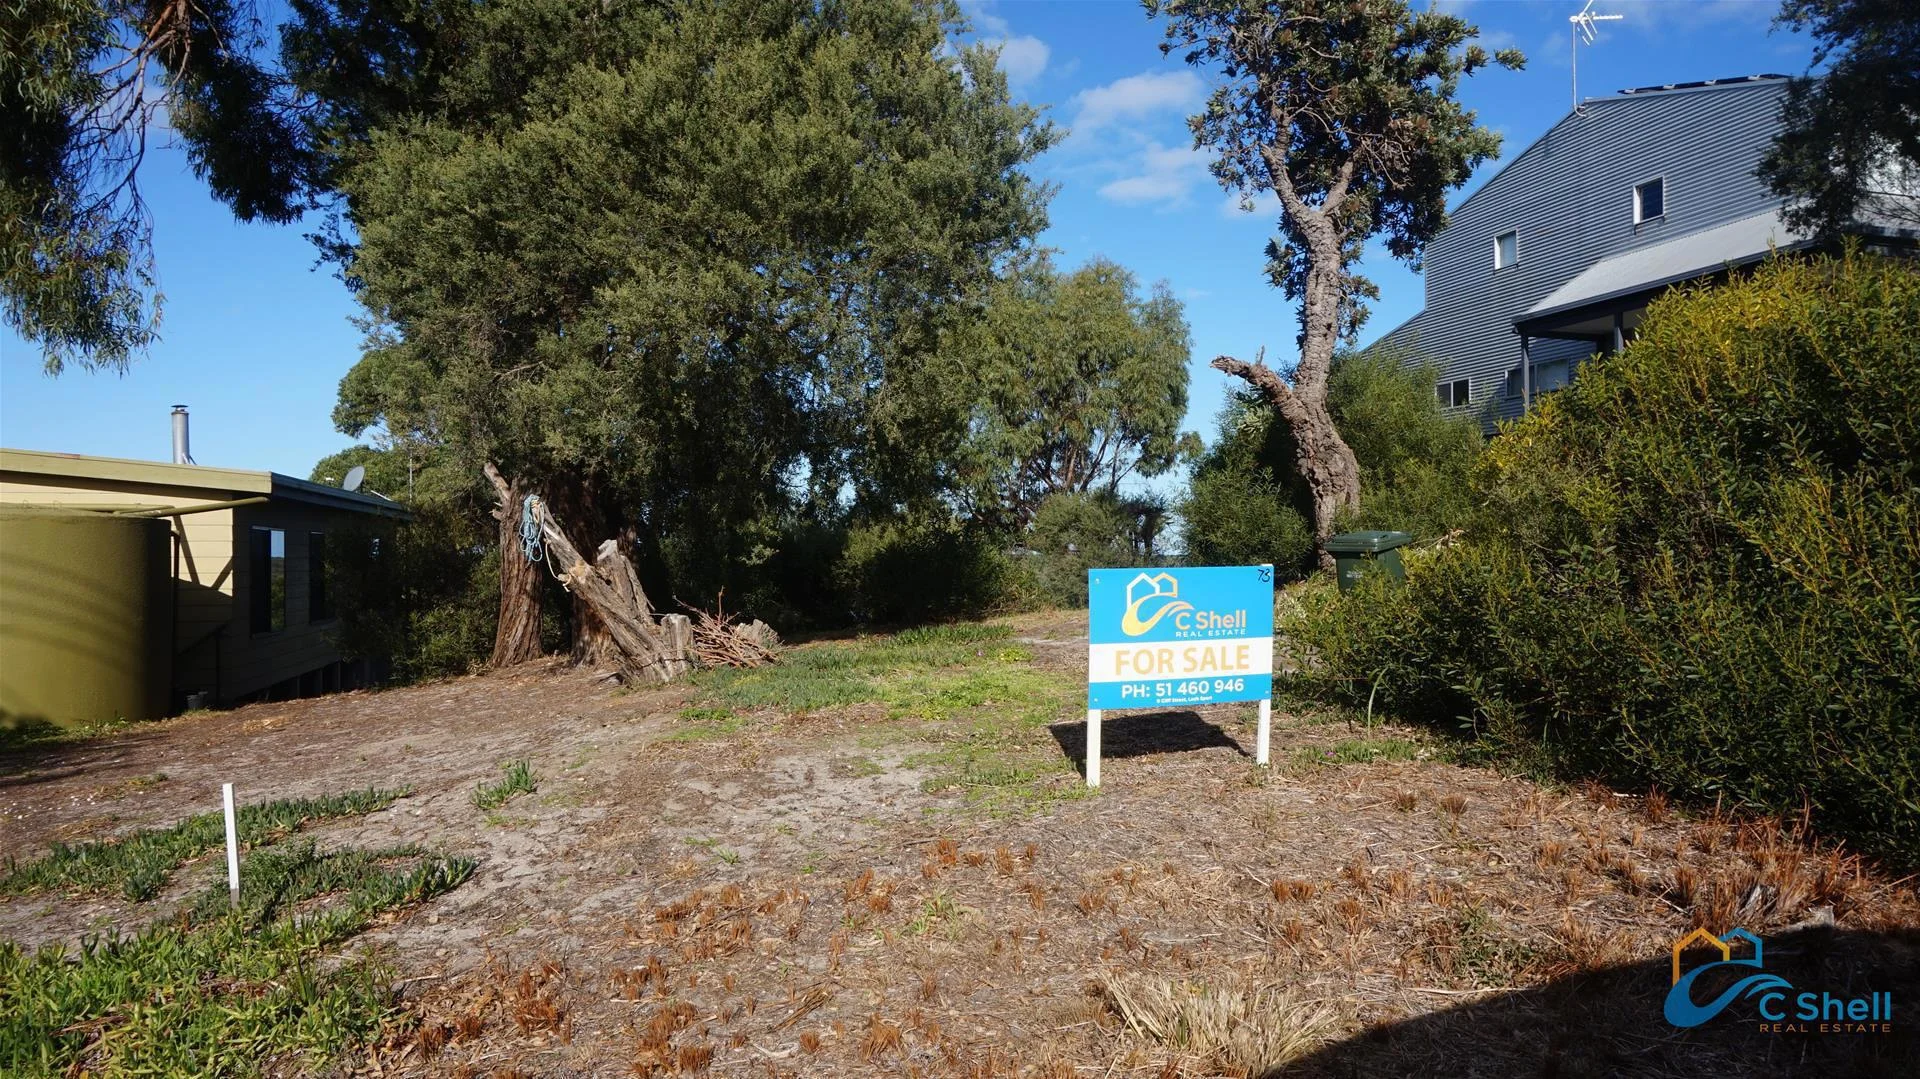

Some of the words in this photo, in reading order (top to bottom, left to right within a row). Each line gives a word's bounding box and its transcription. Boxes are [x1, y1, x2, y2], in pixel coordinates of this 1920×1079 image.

[1257, 568, 1271, 583] 73
[1175, 613, 1190, 630] C
[1196, 610, 1246, 628] Shell
[1175, 630, 1203, 638] REAL
[1208, 628, 1246, 637] ESTATE
[1115, 648, 1175, 676] FOR
[1183, 645, 1250, 674] SALE
[1121, 684, 1150, 699] PH:
[1155, 682, 1172, 697] 51
[1177, 680, 1209, 696] 460
[1214, 678, 1245, 693] 946
